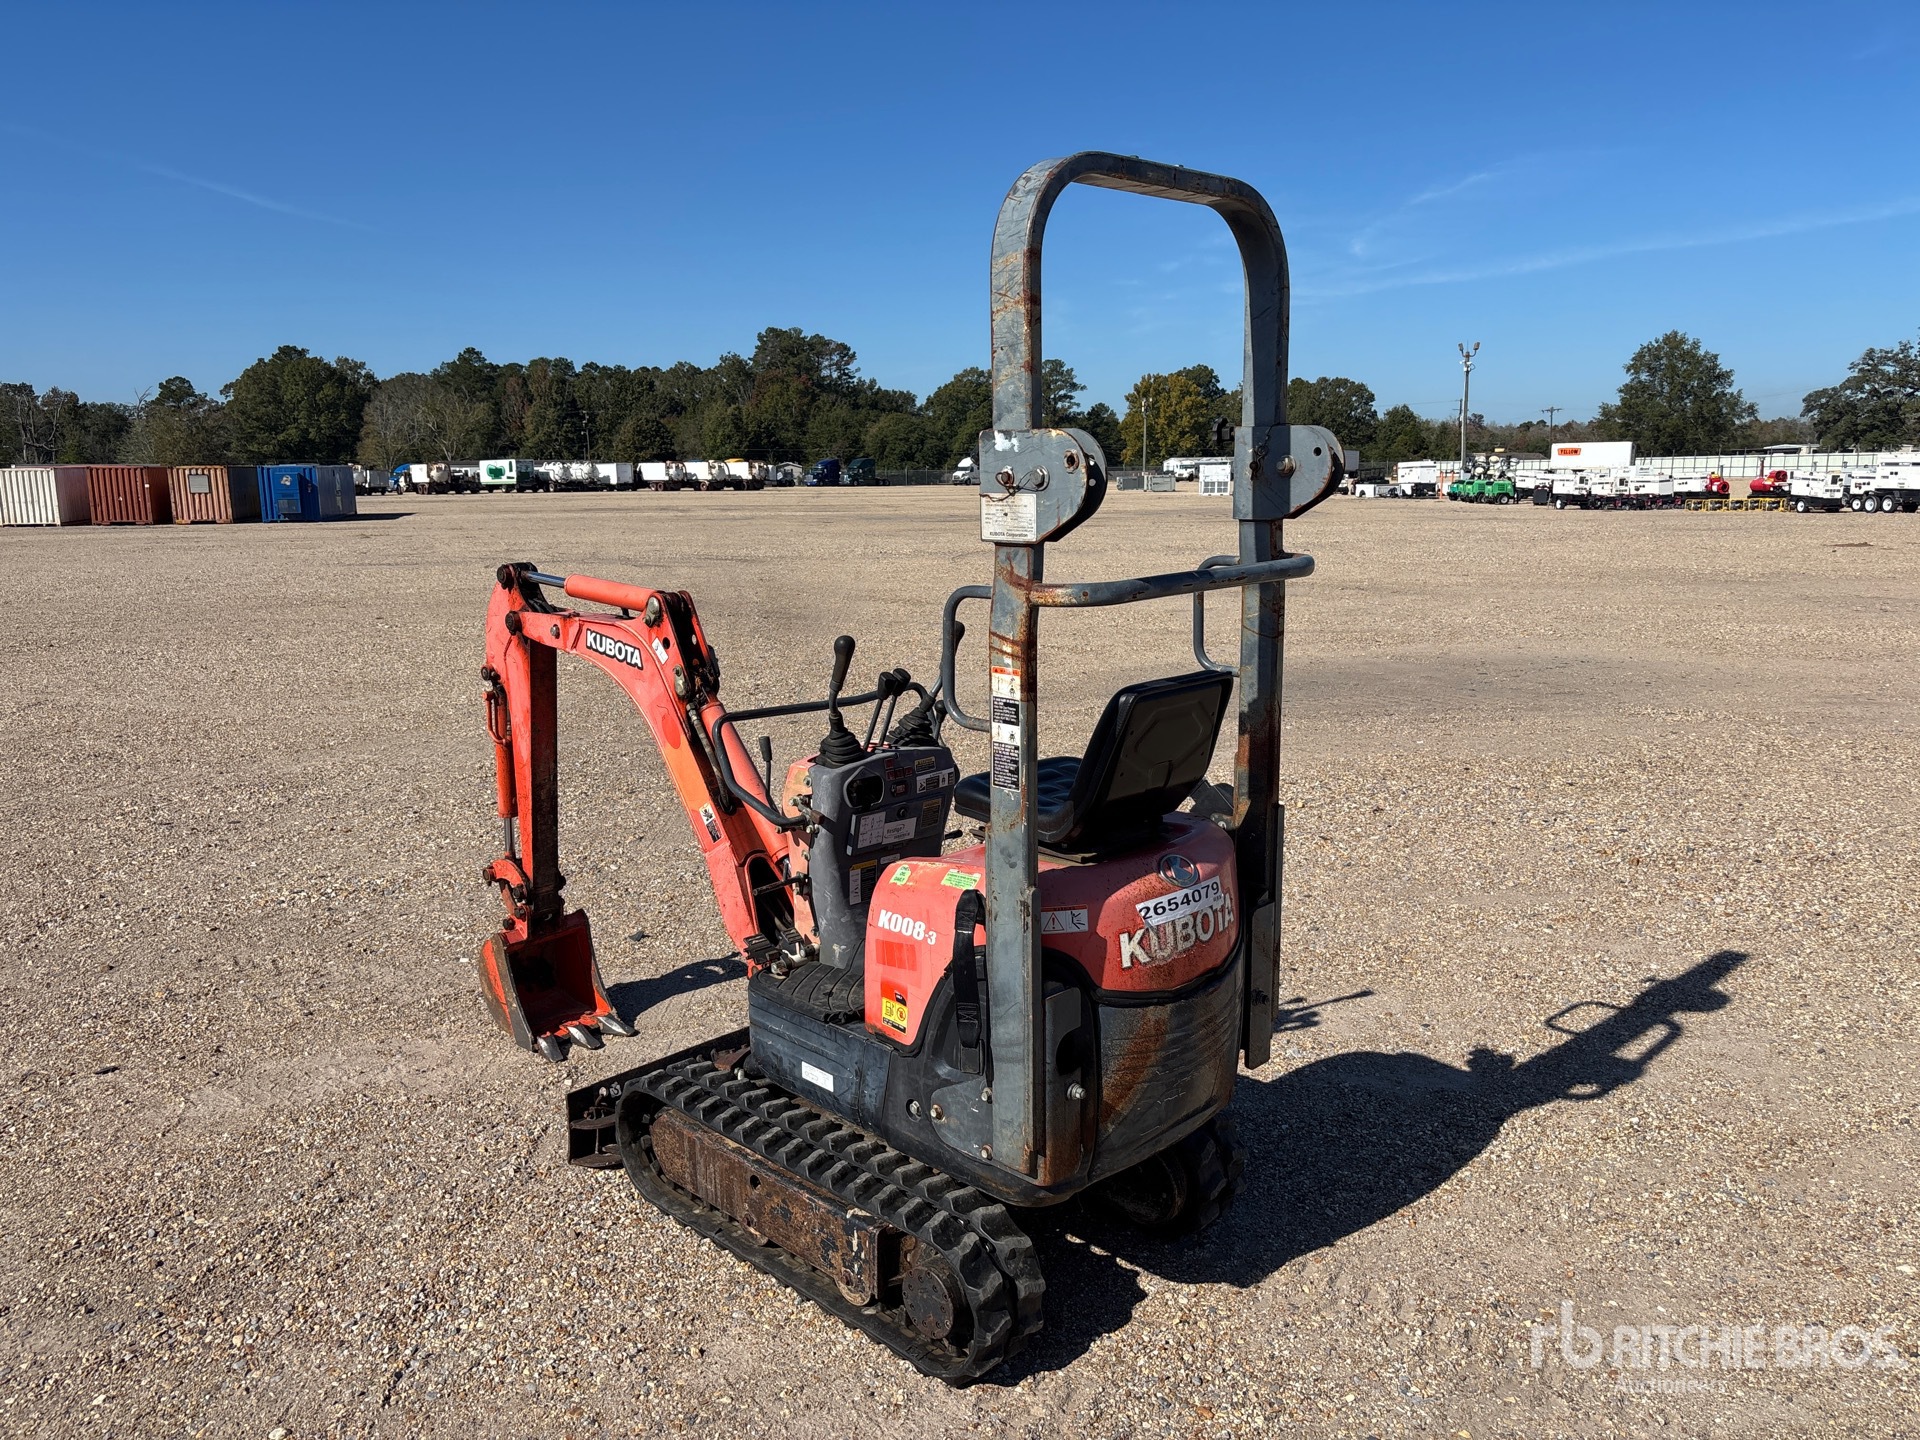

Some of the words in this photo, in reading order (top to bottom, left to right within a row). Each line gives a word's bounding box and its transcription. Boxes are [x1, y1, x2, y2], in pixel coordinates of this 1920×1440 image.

[586, 629, 642, 668] KUBOTA
[1139, 881, 1219, 920] 2654079
[878, 909, 937, 945] K008-3
[1119, 892, 1234, 969] KUBOTA
